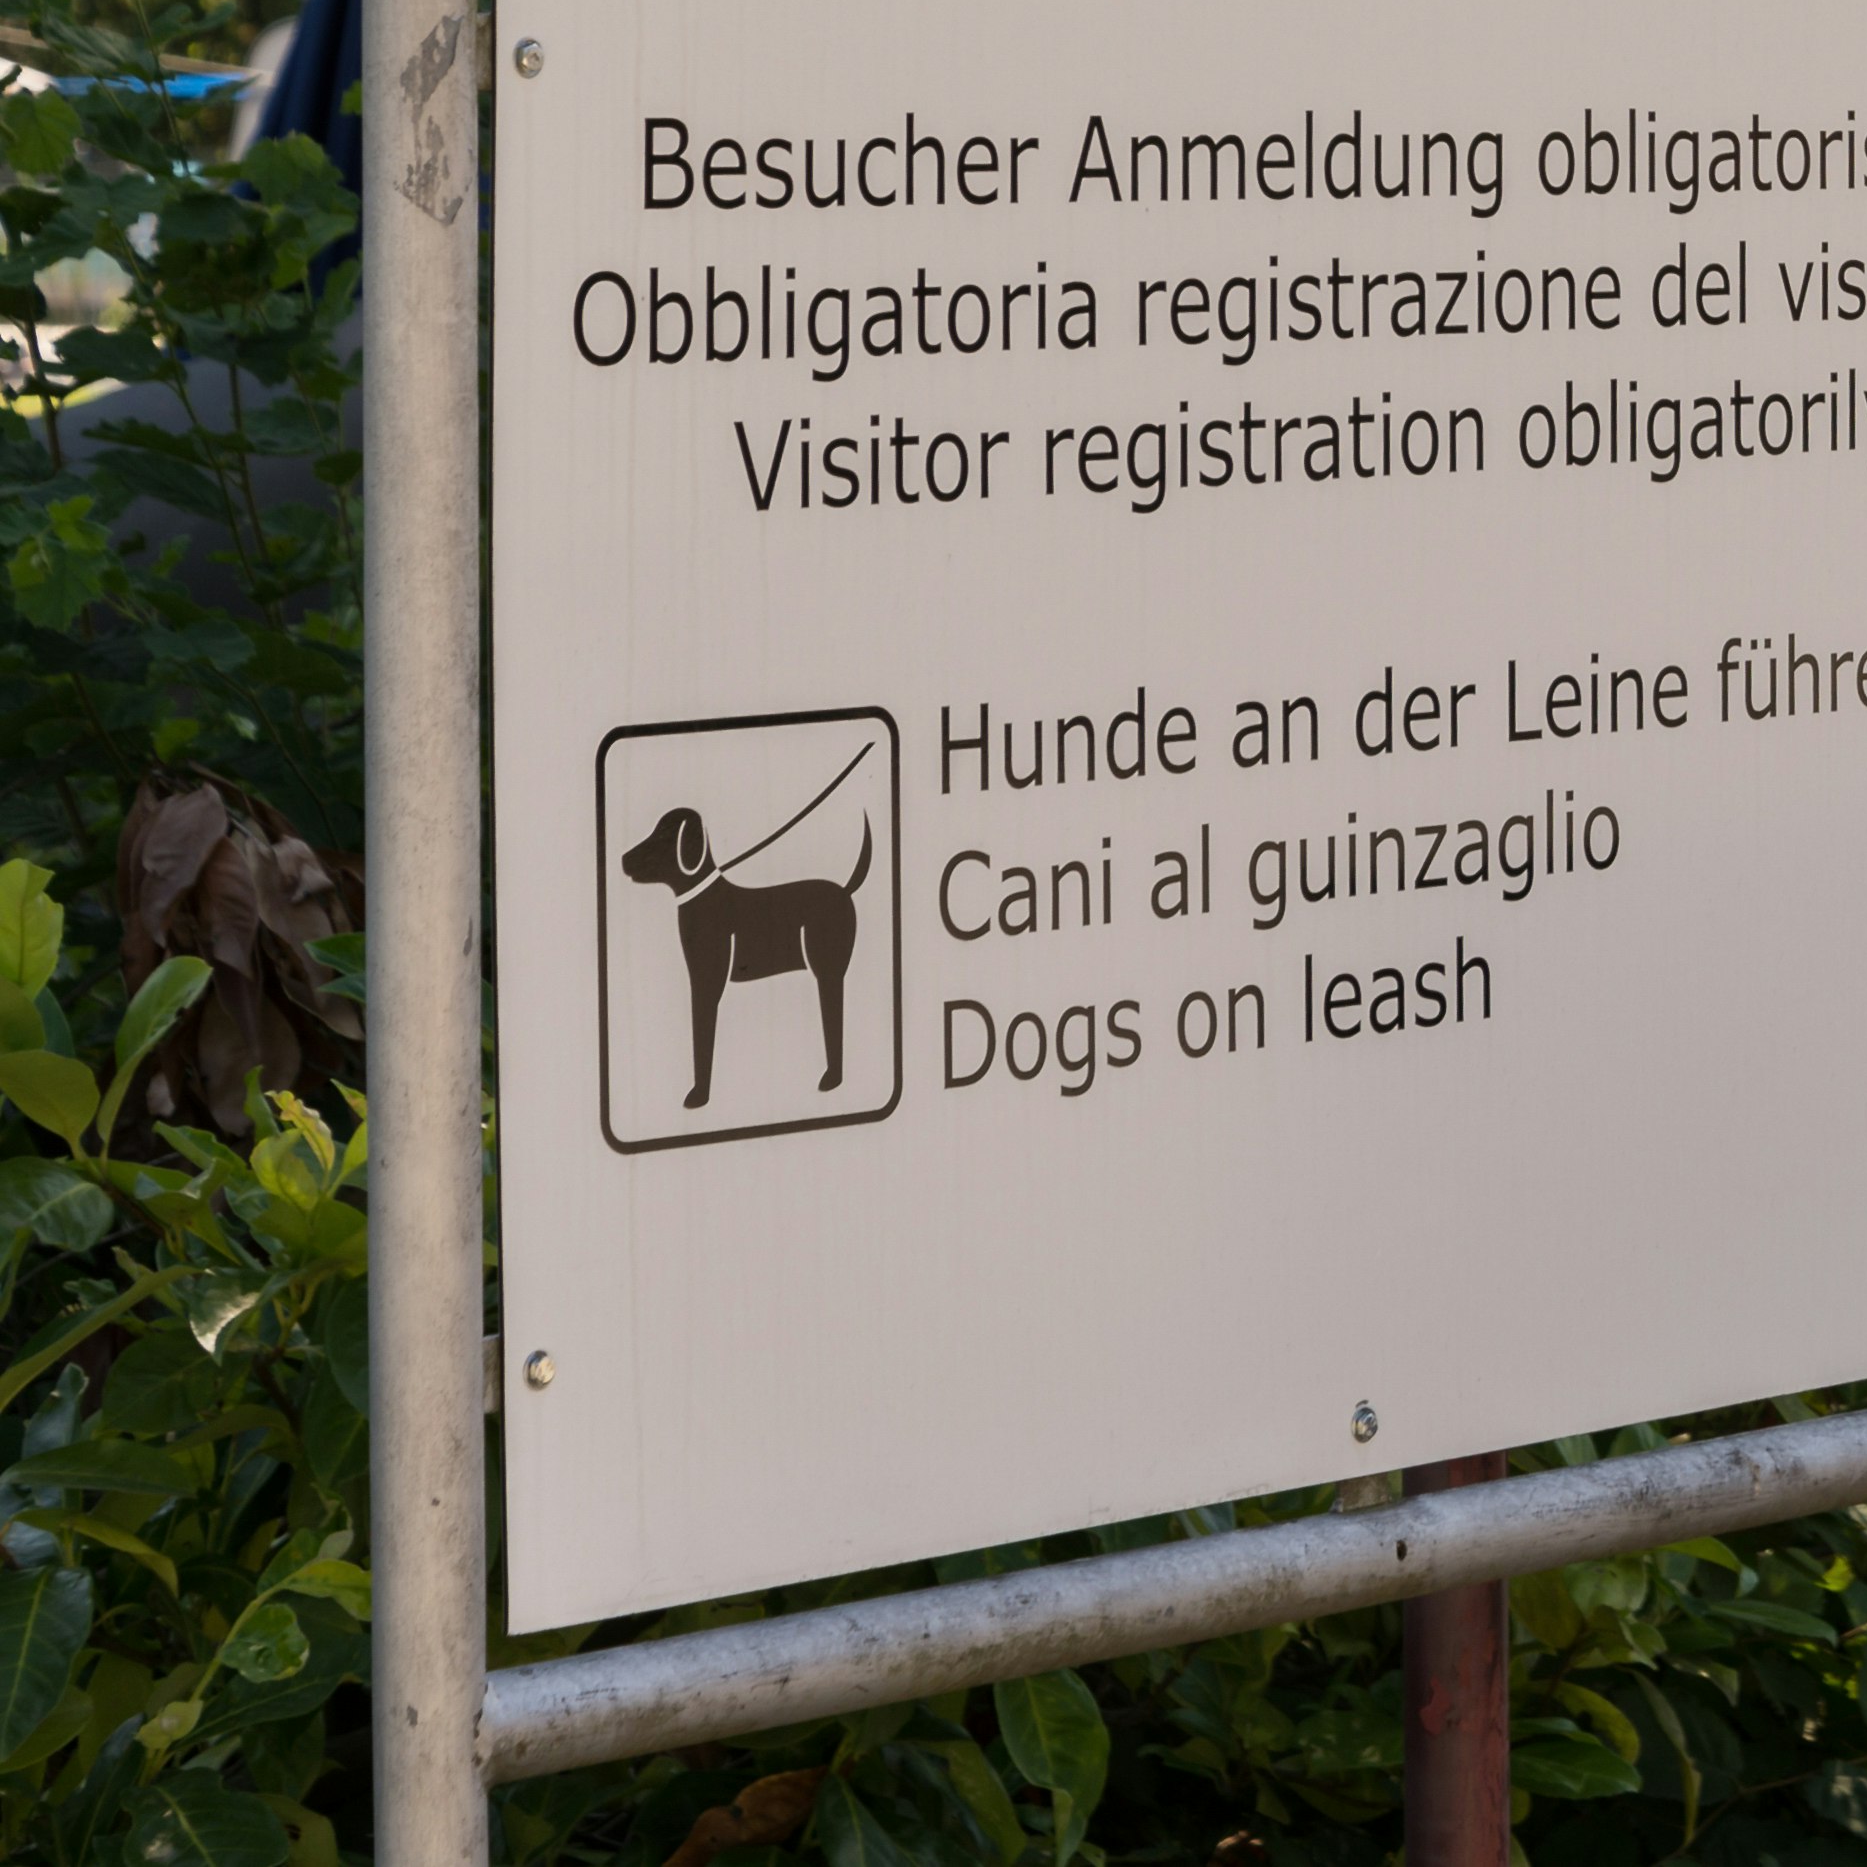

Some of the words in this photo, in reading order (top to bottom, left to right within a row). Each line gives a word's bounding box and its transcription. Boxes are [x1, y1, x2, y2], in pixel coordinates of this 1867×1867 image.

[642, 110, 1041, 211] Besucher
[1067, 108, 1505, 220] Anmeldung
[572, 259, 1098, 384] Obbligatoria
[1137, 248, 1623, 368] registrazione
[1650, 239, 1748, 329] del
[732, 412, 1011, 513] Visitor
[1044, 390, 1485, 516] registration
[939, 684, 1198, 796] Hunde
[1231, 695, 1320, 770] an
[1354, 664, 1478, 758] der
[1506, 651, 1690, 744] Leine
[937, 835, 1113, 943] Cani
[1149, 822, 1211, 921] al
[1247, 787, 1621, 932] guinzaglio
[942, 997, 1143, 1099] Dogs
[1175, 983, 1266, 1060] on
[1303, 934, 1492, 1044] leash
